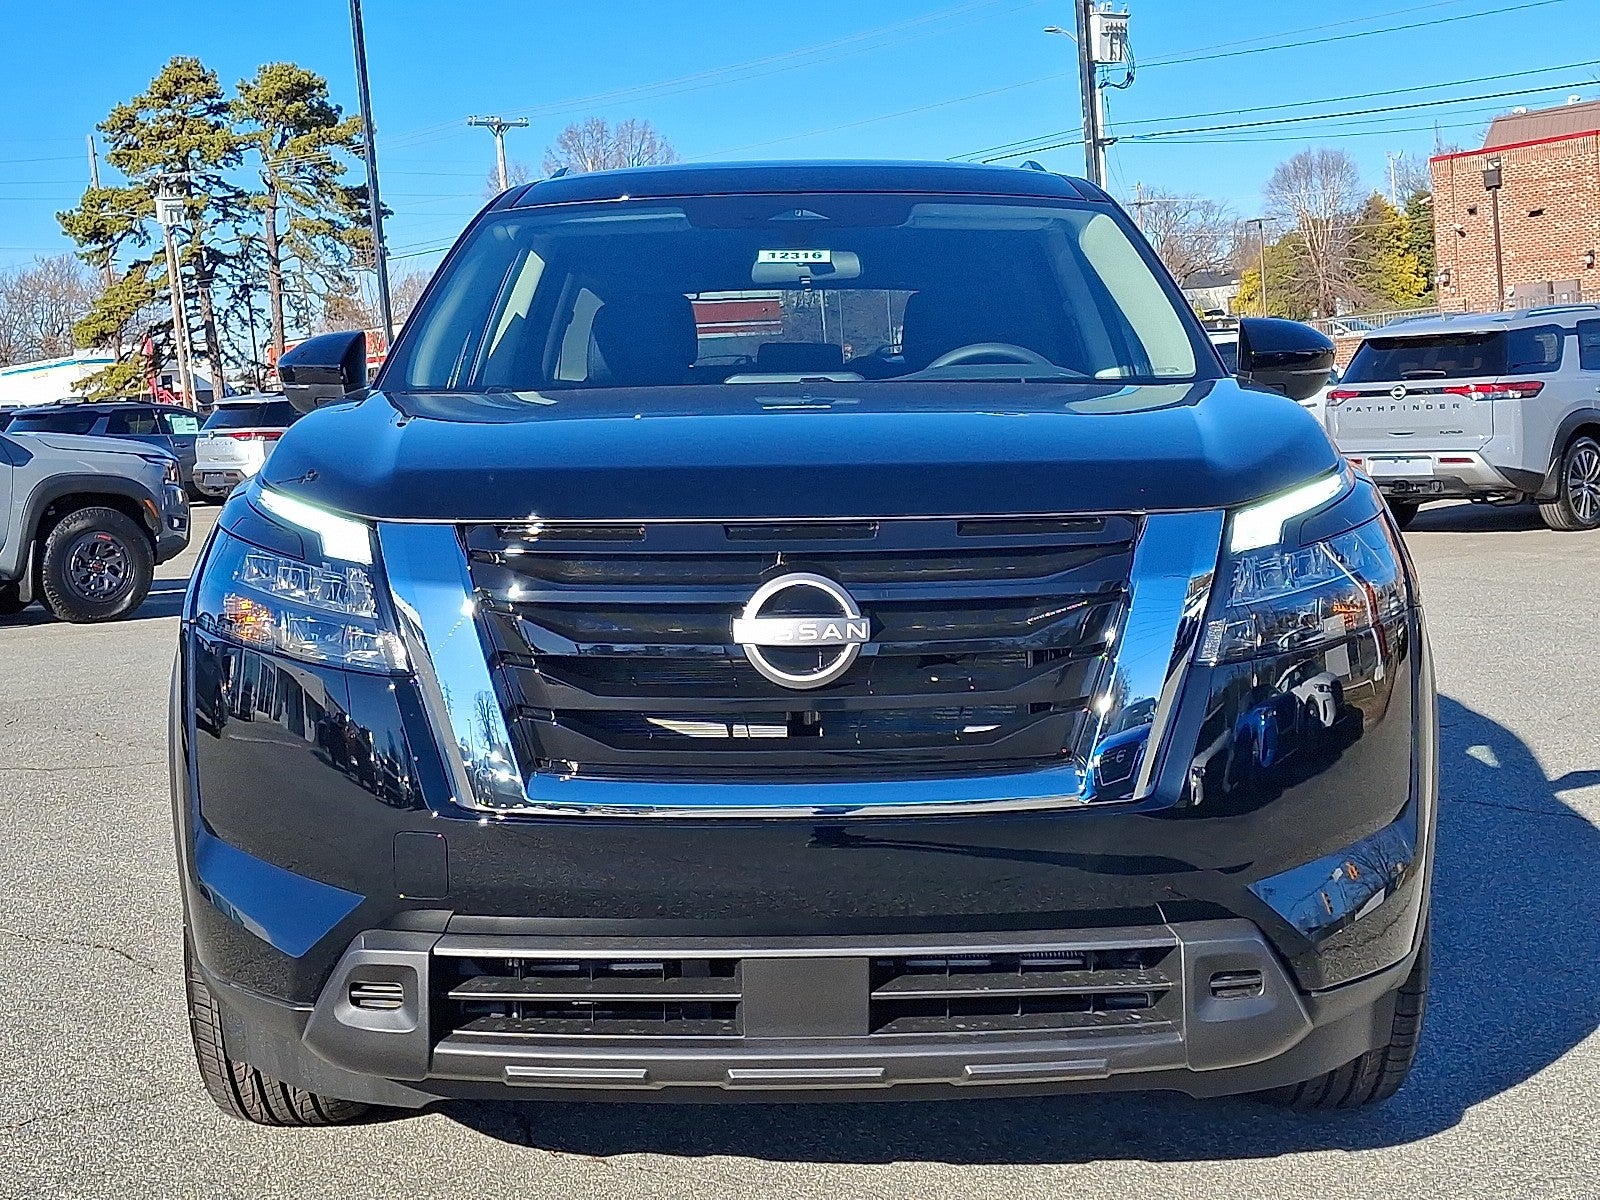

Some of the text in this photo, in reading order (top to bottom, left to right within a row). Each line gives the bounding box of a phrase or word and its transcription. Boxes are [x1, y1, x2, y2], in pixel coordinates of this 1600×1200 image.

[767, 251, 823, 260] 12316
[1345, 403, 1461, 413] PATHFINDER
[748, 621, 867, 641] SSAN
